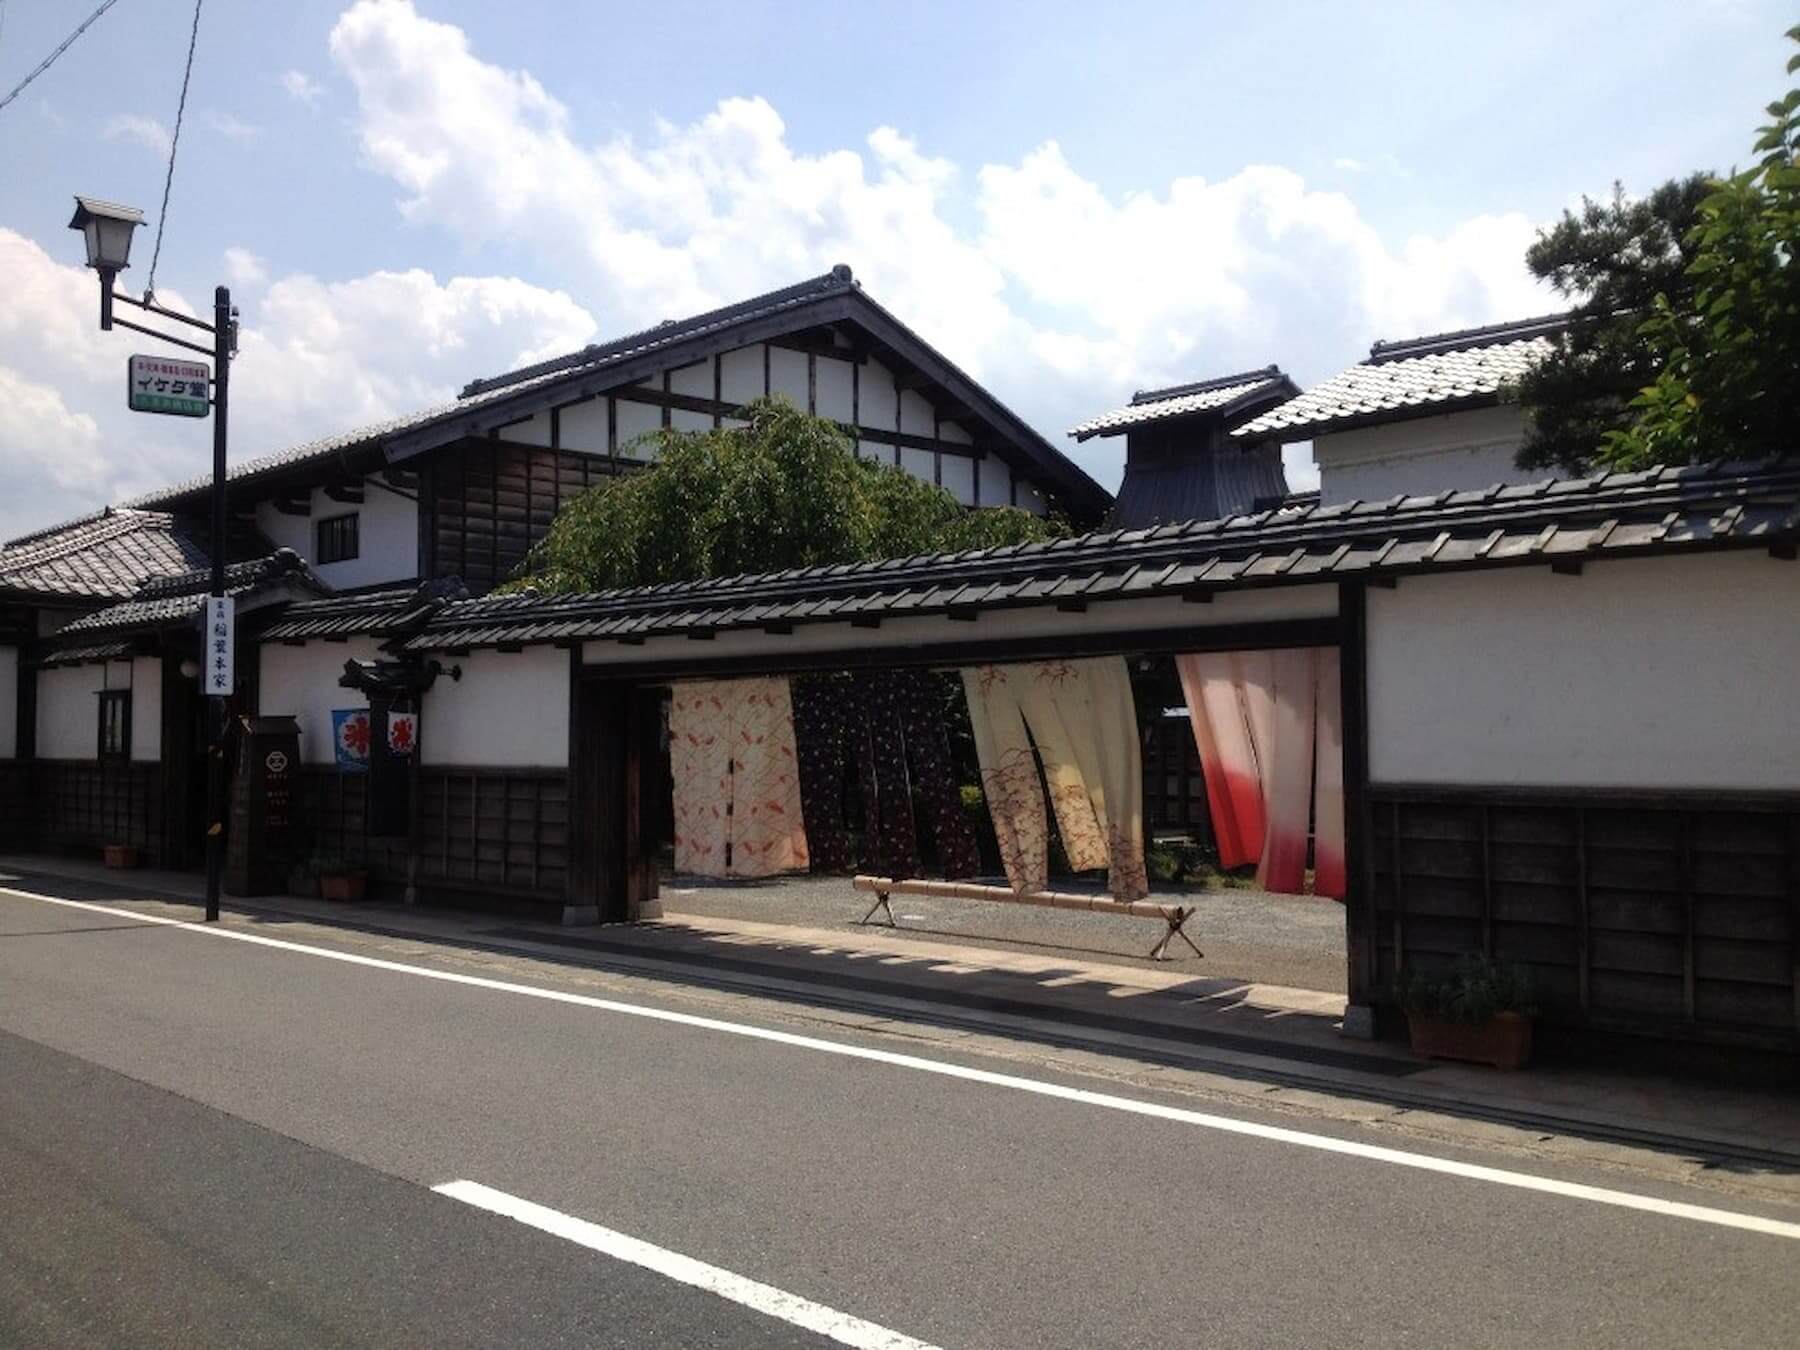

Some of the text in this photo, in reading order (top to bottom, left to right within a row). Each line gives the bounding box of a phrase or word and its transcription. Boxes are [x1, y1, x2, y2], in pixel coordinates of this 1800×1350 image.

[138, 376, 206, 398] イケダ堂
[213, 623, 227, 688] 稲葉本家
